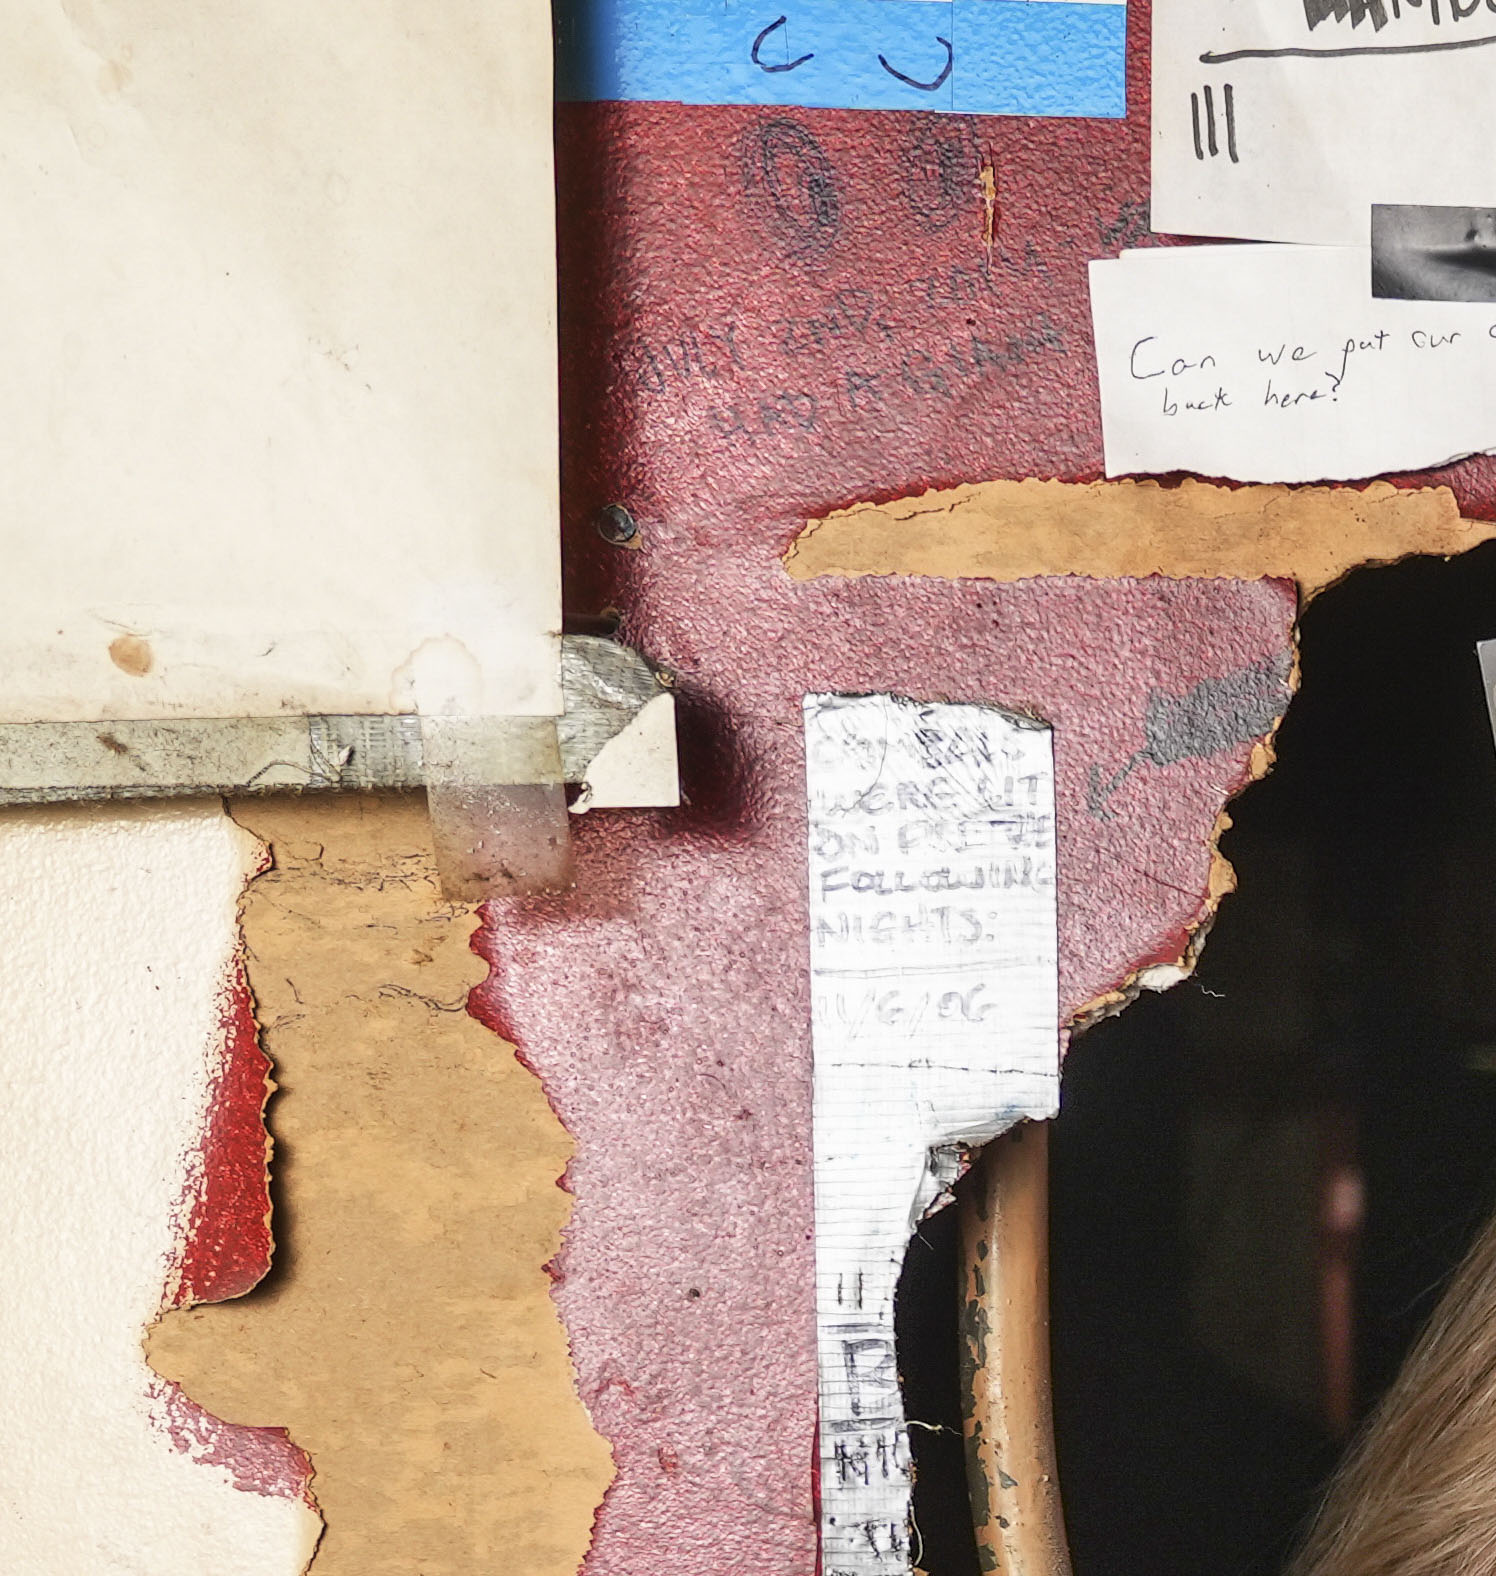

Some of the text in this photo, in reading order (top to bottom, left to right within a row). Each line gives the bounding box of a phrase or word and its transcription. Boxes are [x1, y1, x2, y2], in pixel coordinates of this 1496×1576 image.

[1130, 337, 1216, 380] Can
[1258, 343, 1315, 364] we
[1340, 331, 1390, 380] put
[1412, 331, 1460, 348] our
[1265, 372, 1341, 407] here?
